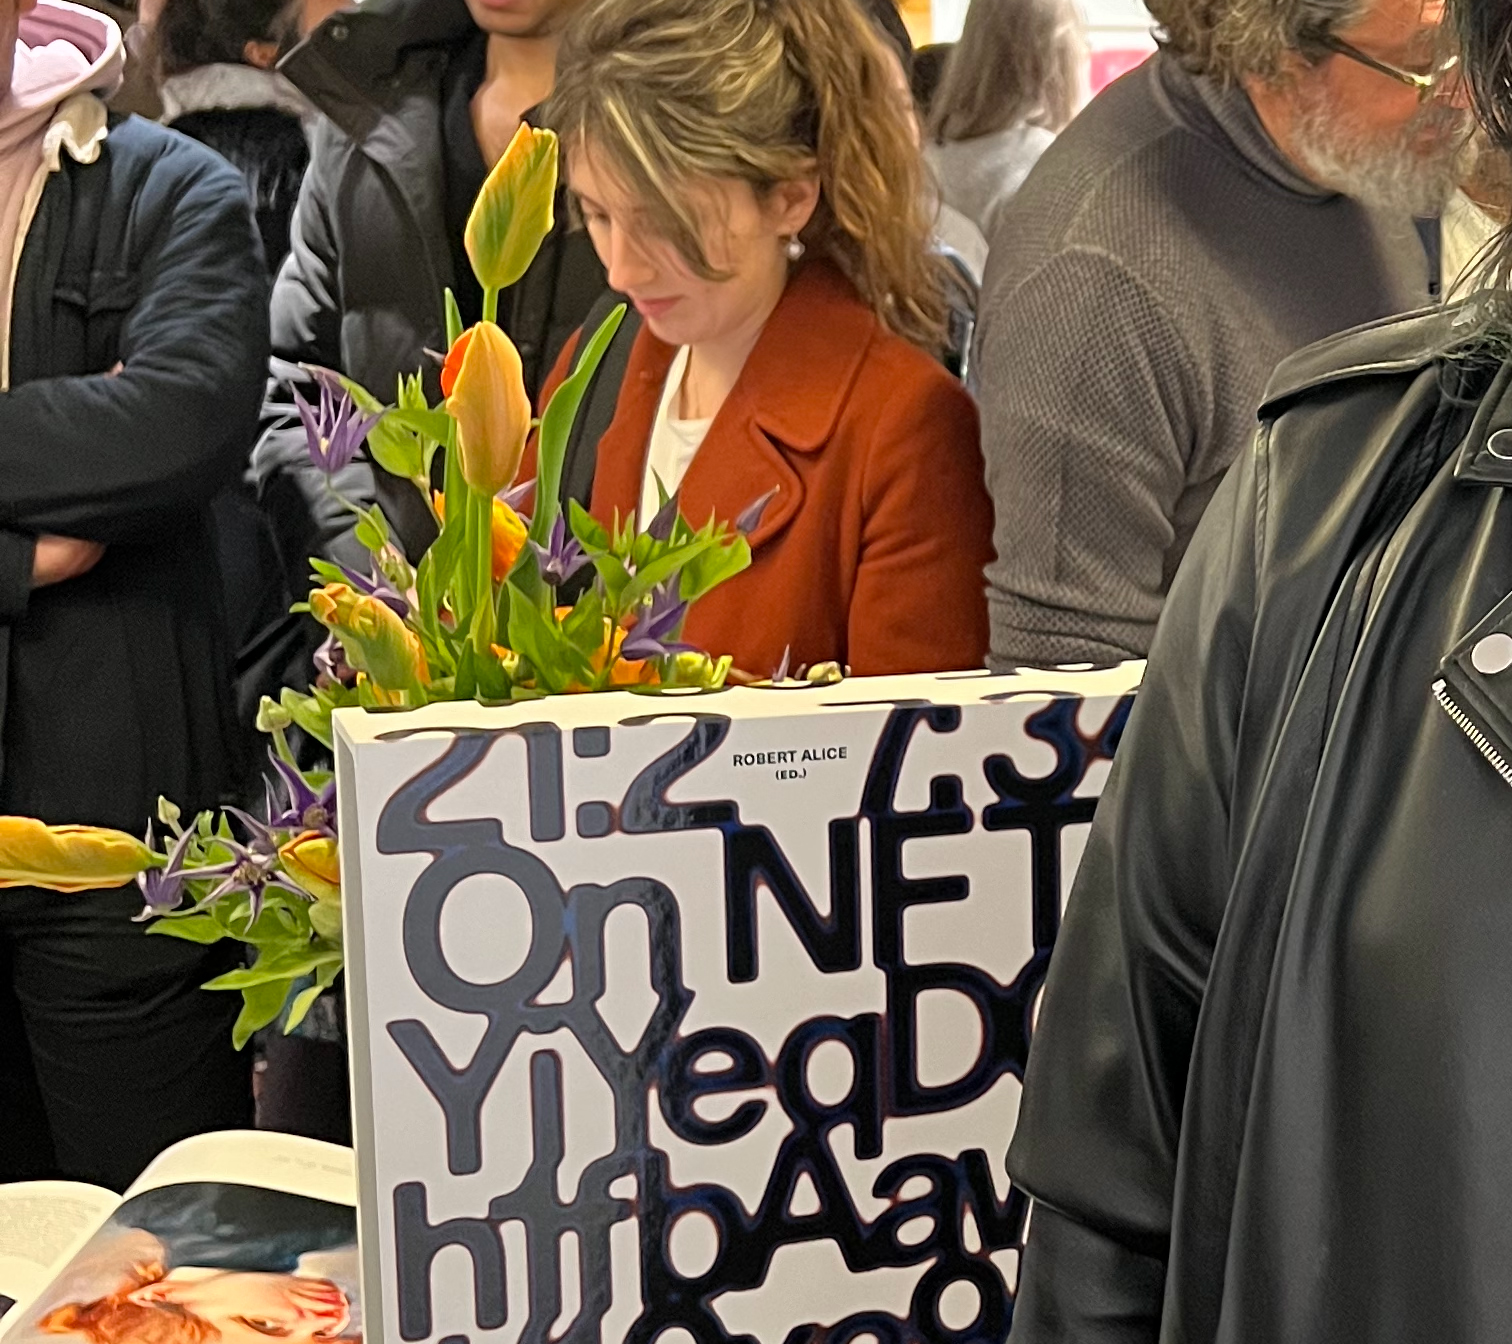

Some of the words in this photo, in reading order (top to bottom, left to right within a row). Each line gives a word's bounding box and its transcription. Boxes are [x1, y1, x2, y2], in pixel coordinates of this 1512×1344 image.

[733, 750, 797, 767] ROBERT
[801, 746, 847, 762] ALICE
[775, 768, 807, 780] (ED.)
